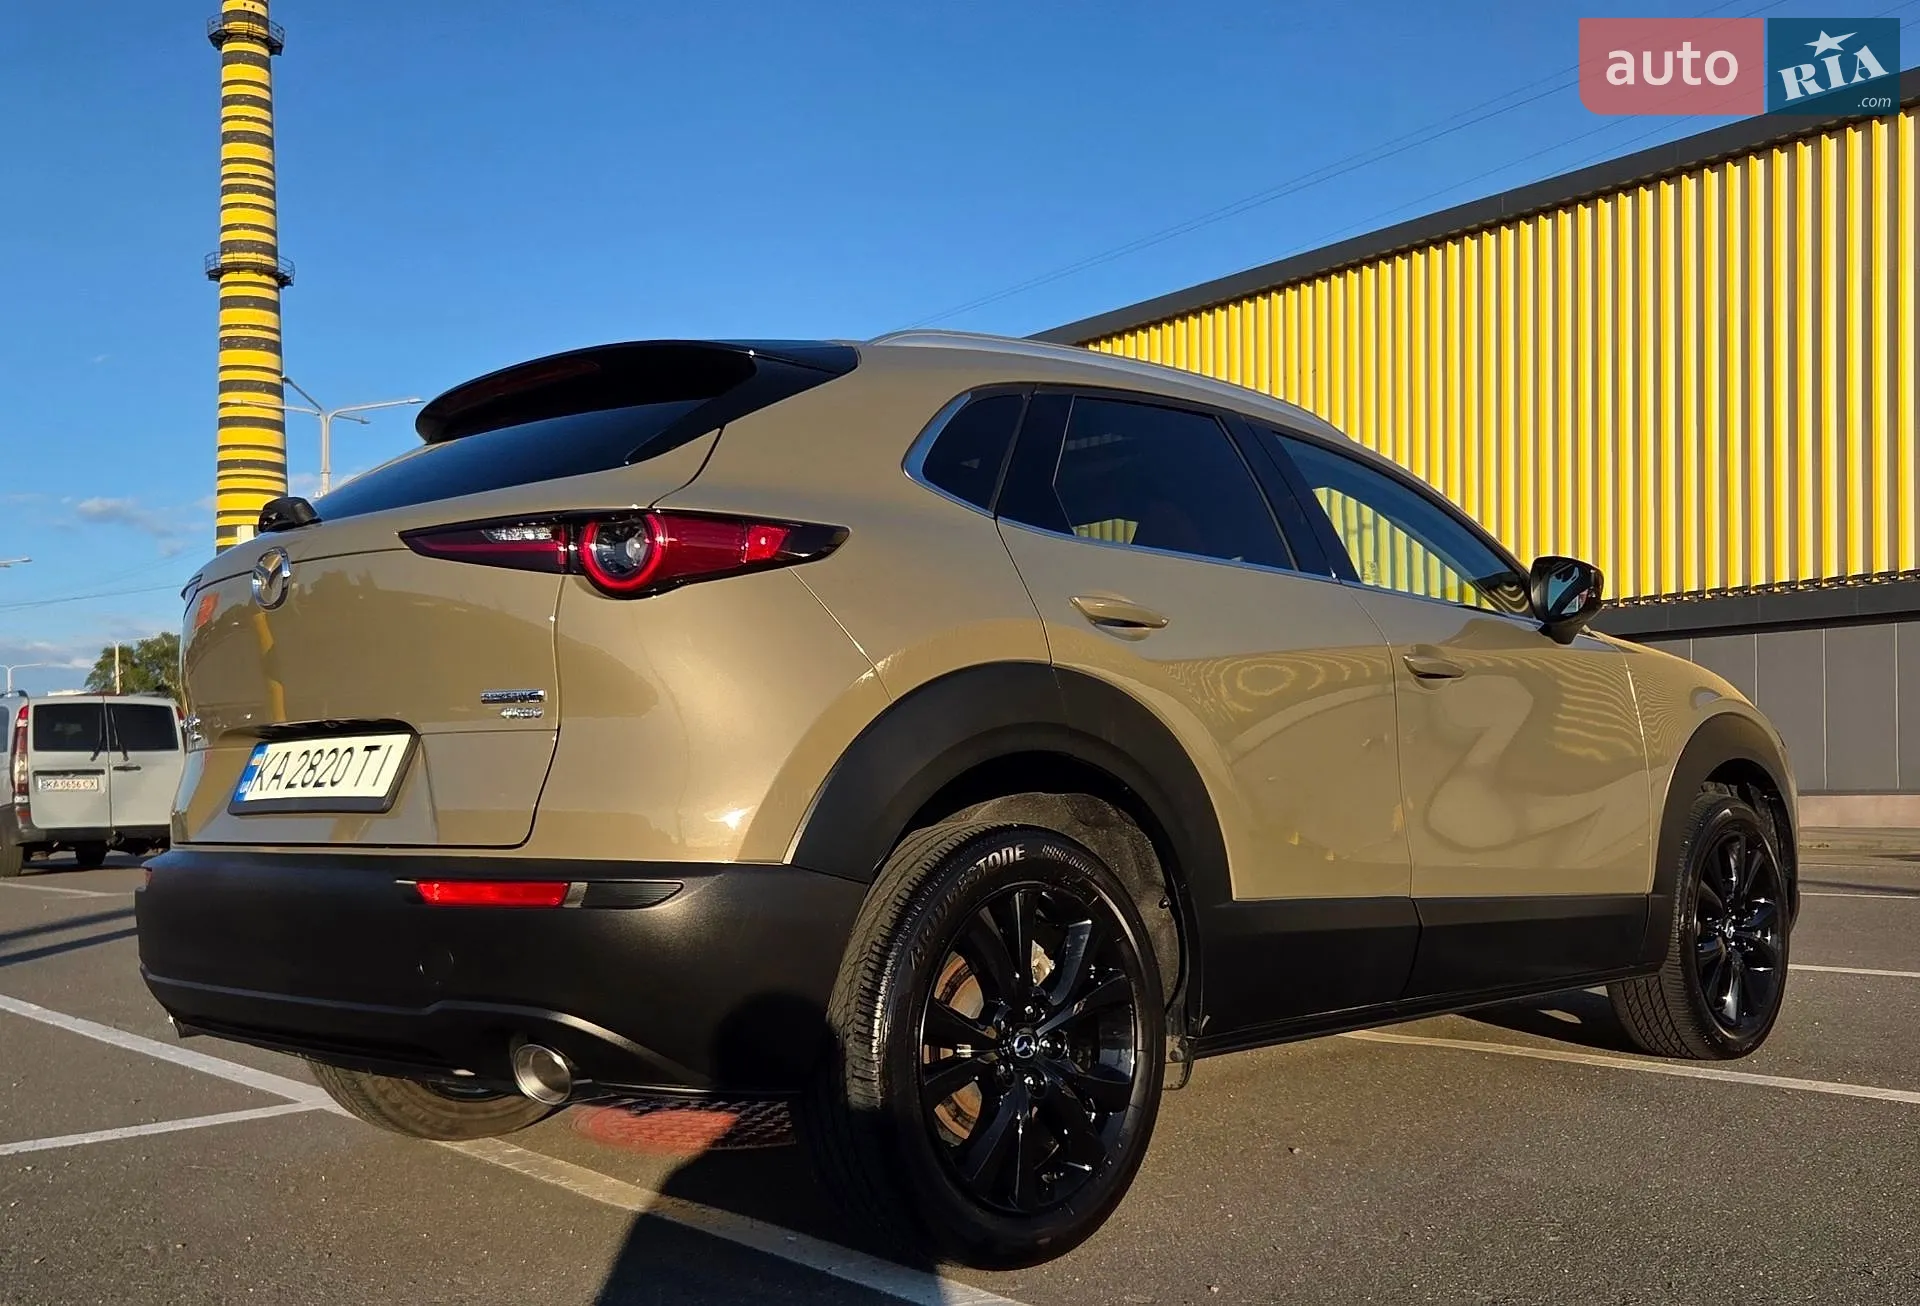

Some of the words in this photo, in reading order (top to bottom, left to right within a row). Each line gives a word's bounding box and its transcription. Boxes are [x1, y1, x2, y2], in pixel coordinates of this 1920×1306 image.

[251, 751, 291, 792] KA
[285, 747, 354, 788] 2820
[354, 744, 393, 788] TI
